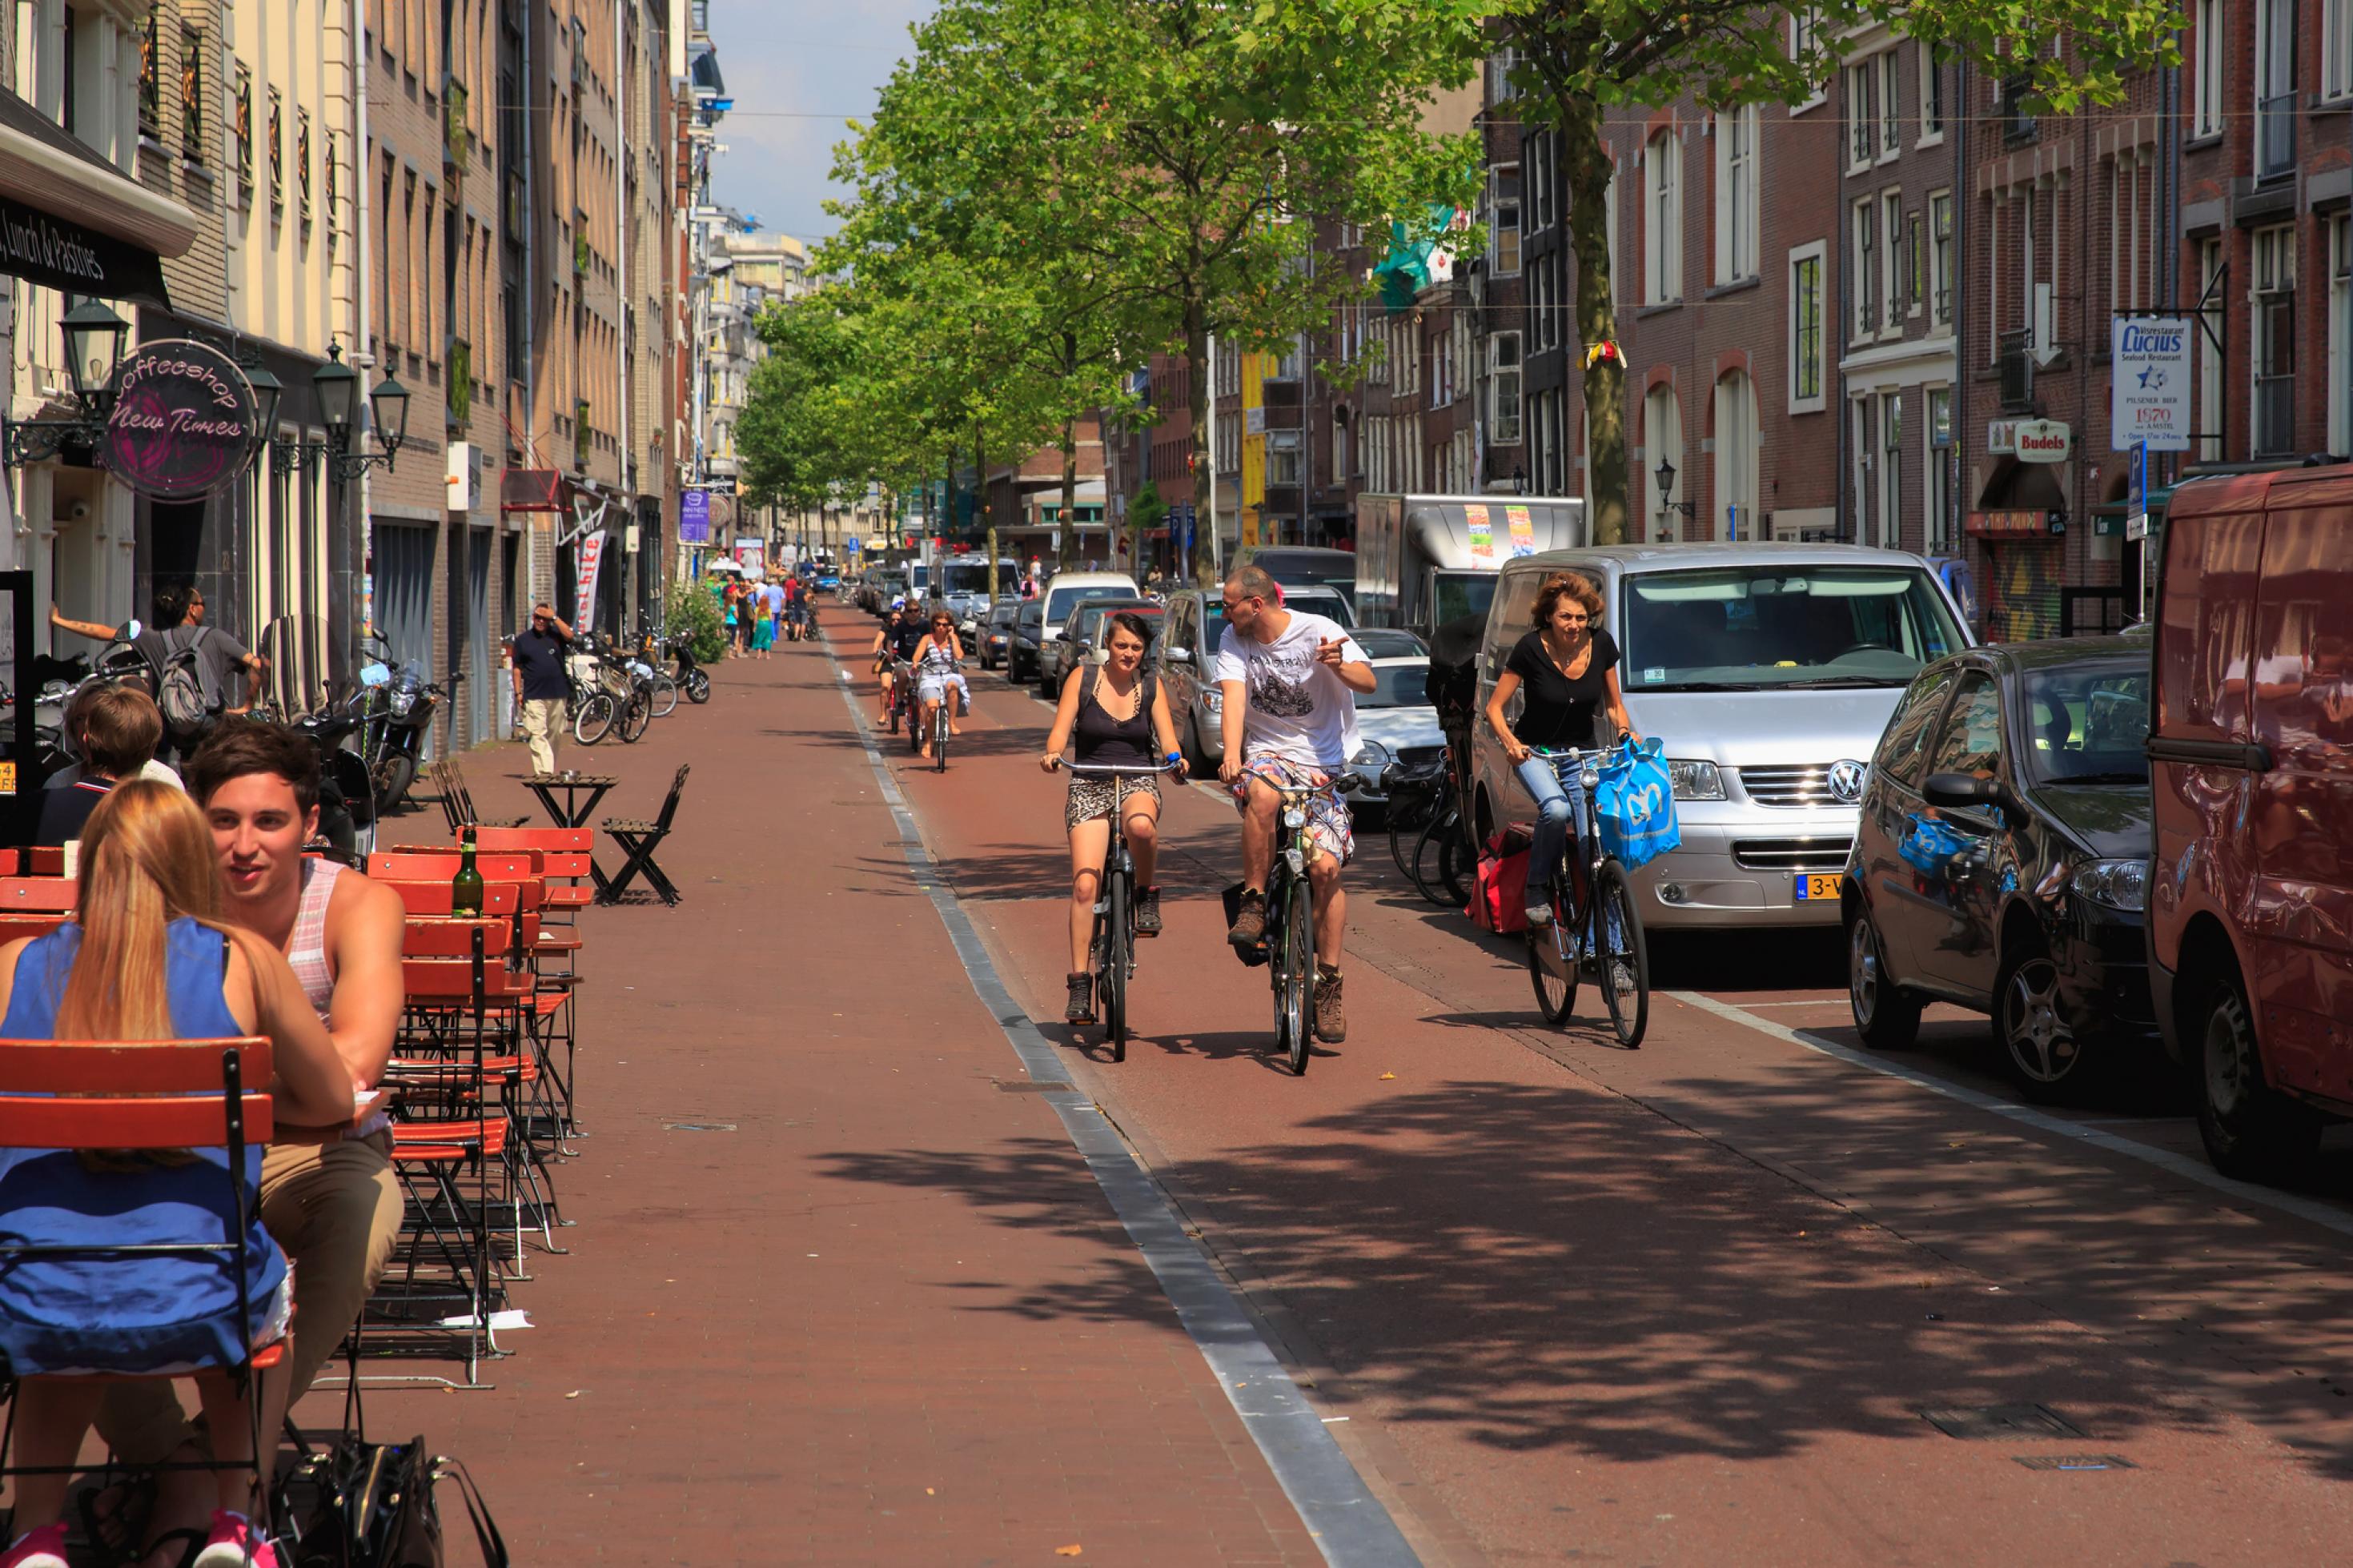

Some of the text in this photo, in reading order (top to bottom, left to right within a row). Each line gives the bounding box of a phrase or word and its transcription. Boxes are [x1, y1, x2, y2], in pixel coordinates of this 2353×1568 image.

[51, 227, 104, 280] Pastries
[2122, 325, 2182, 352] Lucius
[2140, 327, 2184, 335] Visrestaurant
[2122, 353, 2146, 361] Seafood
[108, 401, 241, 436] New Times
[2136, 408, 2171, 423] 1870
[2022, 435, 2065, 449] Budels
[2132, 449, 2141, 481] P
